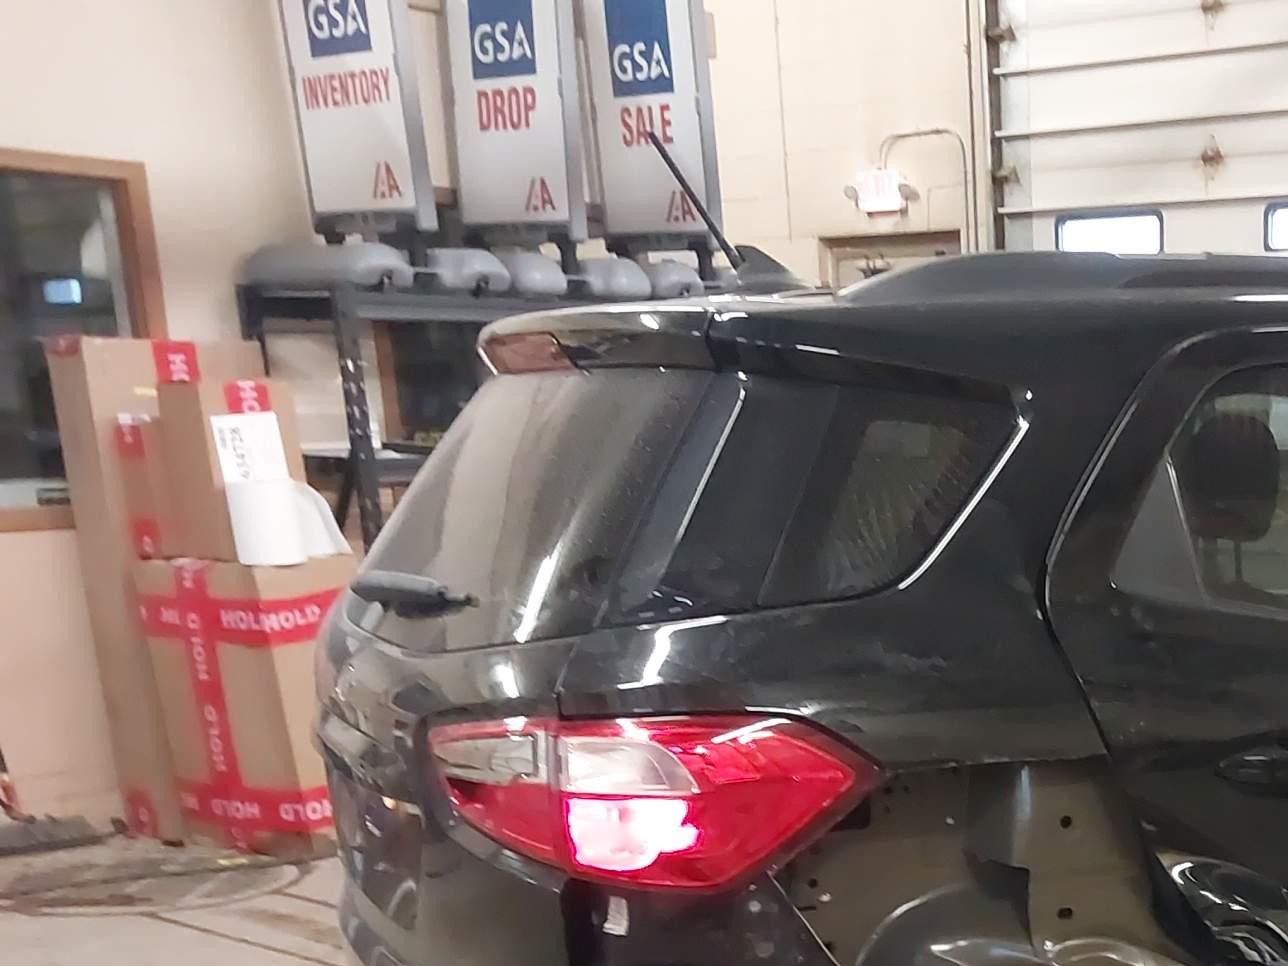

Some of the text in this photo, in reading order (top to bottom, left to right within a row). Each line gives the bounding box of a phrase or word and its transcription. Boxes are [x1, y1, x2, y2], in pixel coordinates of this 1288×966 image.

[308, 0, 367, 39] GSA
[474, 20, 532, 64] GSA
[613, 40, 670, 82] GSA
[302, 67, 390, 110] INVENTORY
[476, 86, 537, 132] DROP
[620, 104, 674, 147] SALE
